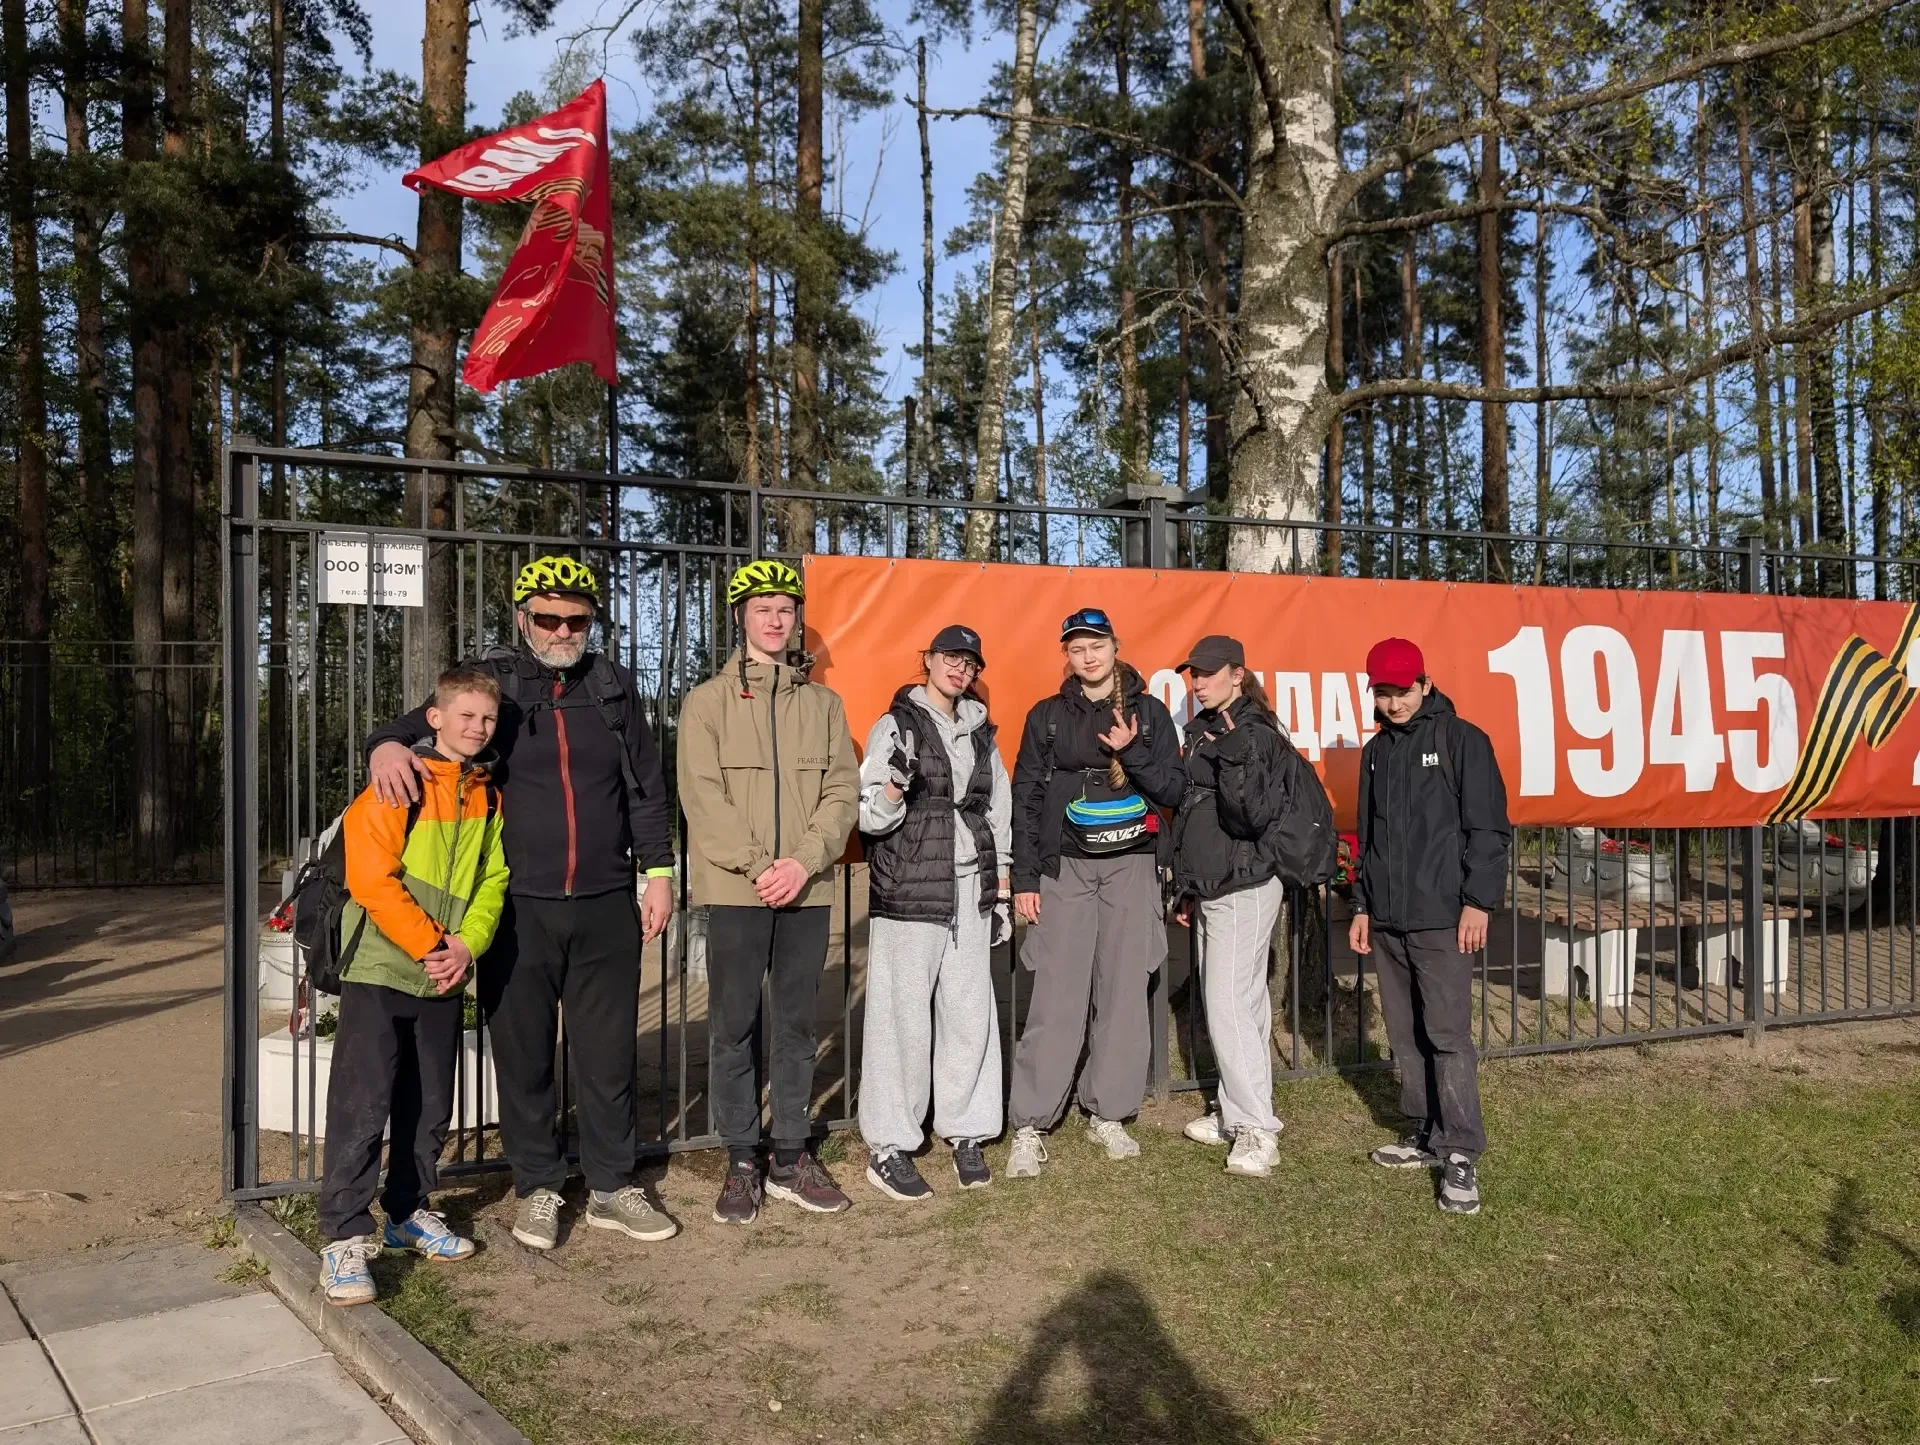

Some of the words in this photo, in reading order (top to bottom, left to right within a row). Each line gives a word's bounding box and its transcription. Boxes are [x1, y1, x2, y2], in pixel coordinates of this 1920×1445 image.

[320, 538, 358, 548] ОБЪЕКТ
[360, 540, 423, 551] ОСЛУЖИВАЕ
[324, 560, 360, 573] ООО
[363, 589, 408, 597] 54-80-79
[1487, 625, 1799, 798] 1945
